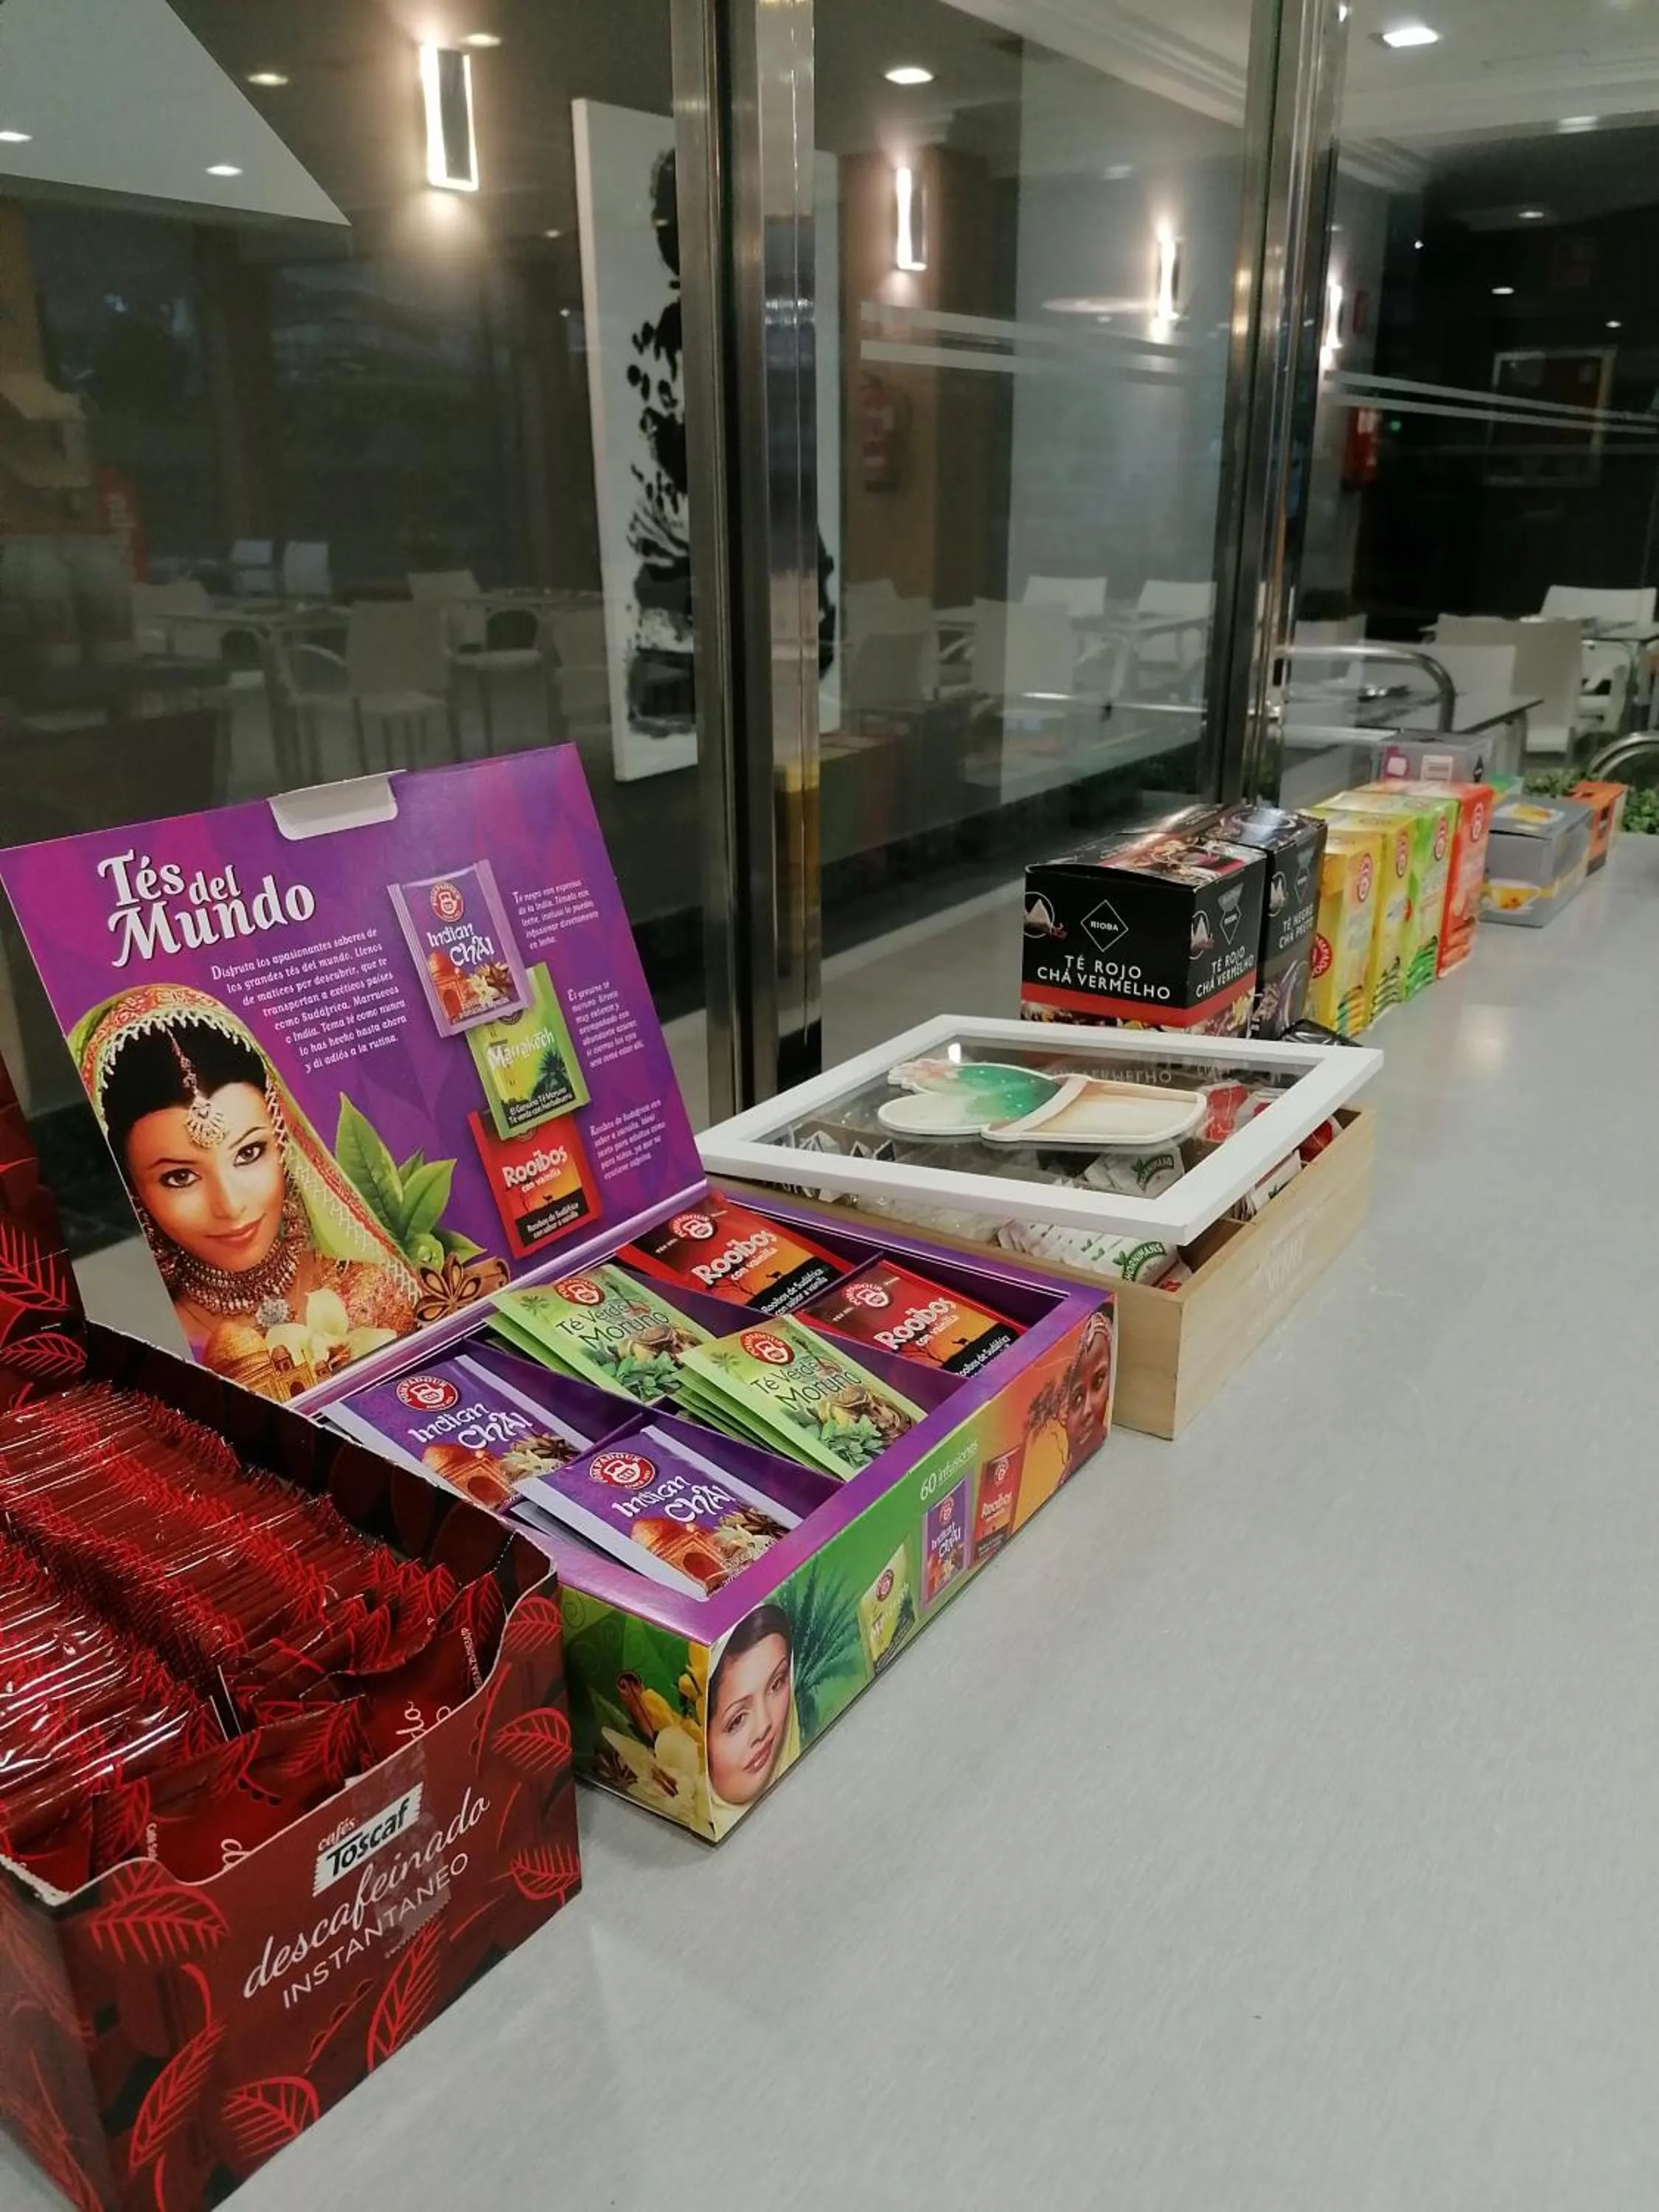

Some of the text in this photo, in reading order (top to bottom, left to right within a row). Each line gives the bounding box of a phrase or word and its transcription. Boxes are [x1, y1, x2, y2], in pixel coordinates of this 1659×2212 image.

[97, 849, 241, 907] Tés del
[108, 875, 316, 967] Mundo
[426, 923, 474, 947] Indian
[1091, 920, 1119, 932] RIOBA
[1282, 916, 1293, 932] TÉ
[212, 928, 377, 981] Disfruta los apasionantes sabores de
[1065, 955, 1141, 980] TÉ ROJO
[1211, 945, 1246, 973] TÉ ROJO
[1217, 955, 1255, 987] VERMELHO
[227, 984, 242, 994] los
[244, 973, 284, 991] grandes
[285, 966, 300, 978] tés
[302, 961, 318, 973] del
[243, 995, 254, 1006] de
[257, 986, 294, 1002] matices
[296, 981, 311, 993] por
[361, 961, 377, 973] que
[378, 958, 388, 967] te
[262, 972, 393, 1017] transportan a exóticos países
[1037, 964, 1171, 1000] CHÁ VERMELHO
[274, 1017, 300, 1031] como
[352, 987, 399, 1007] Marruecos
[321, 1019, 346, 1033] Toma
[347, 1015, 355, 1025] té
[356, 1009, 378, 1021] como
[379, 1000, 406, 1014] nunca
[299, 1015, 407, 1056] lo has hecho hasta ahora
[305, 1034, 399, 1074] y di adiós a la rutina.
[731, 1265, 749, 1281] con
[1121, 1242, 1166, 1281] HORNIMANS
[555, 1300, 631, 1336] Té Verde
[578, 1310, 669, 1352] Moruno
[915, 1333, 933, 1347] con
[750, 1359, 818, 1394] Té Verde
[774, 1371, 862, 1410] Moruno
[408, 1403, 490, 1443] Indian
[612, 1475, 692, 1517] Indian
[919, 1472, 937, 1501] 60
[317, 1816, 358, 1852] cafés
[326, 1797, 411, 1877] Toscaf
[243, 1787, 491, 1999] descafeinado
[282, 1852, 469, 2009] INSTANTANEO
